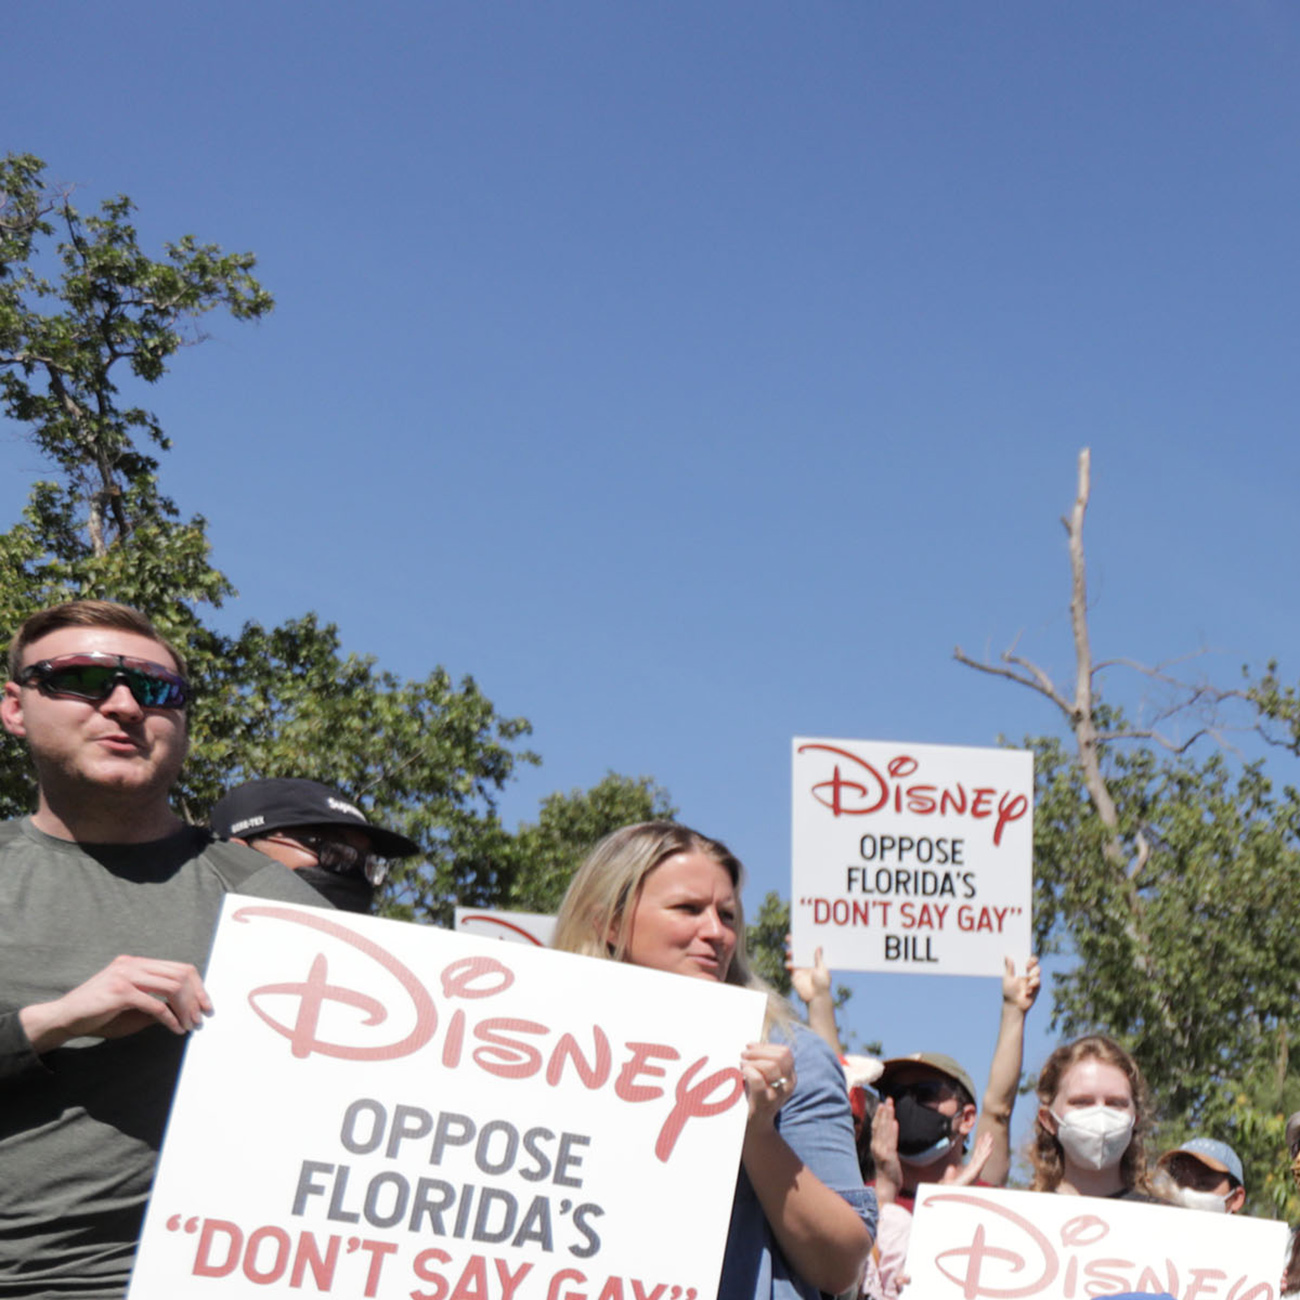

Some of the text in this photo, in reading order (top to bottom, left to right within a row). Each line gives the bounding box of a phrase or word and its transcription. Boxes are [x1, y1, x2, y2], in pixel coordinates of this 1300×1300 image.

[860, 834, 964, 865] OPPOSE
[847, 867, 976, 899] FLORIDA'S
[801, 898, 1023, 934] "DON'T SAY GAY"
[885, 935, 938, 963] BILL
[340, 1099, 591, 1189] OPPOSE
[291, 1161, 605, 1259] FLORIDA'S
[165, 1215, 398, 1298] "DON'T
